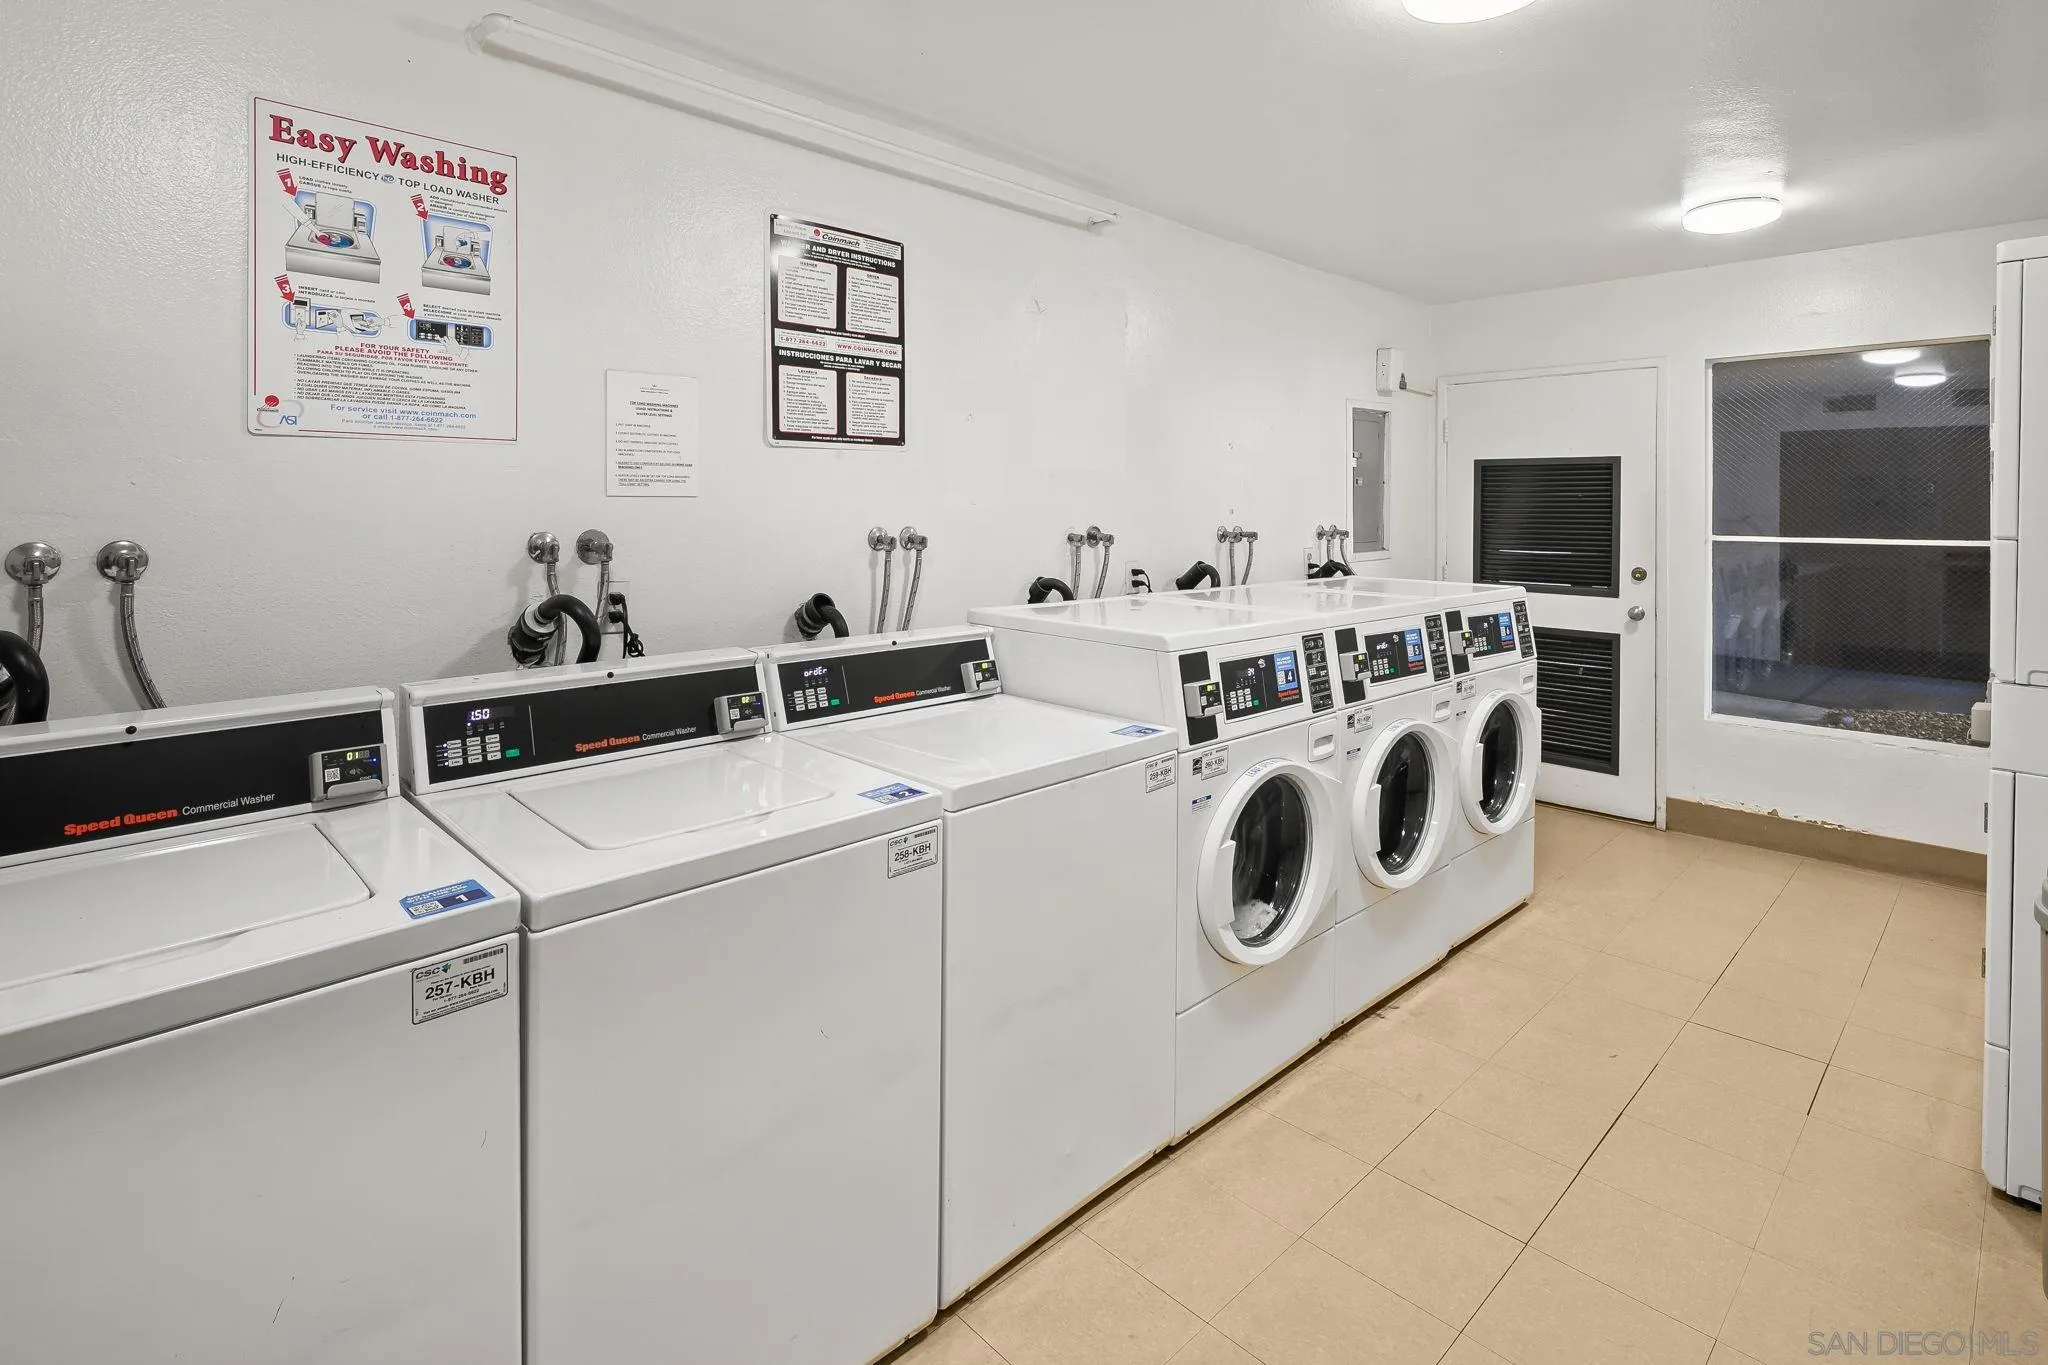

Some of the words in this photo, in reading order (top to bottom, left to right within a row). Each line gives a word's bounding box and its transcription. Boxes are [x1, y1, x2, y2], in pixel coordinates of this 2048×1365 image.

[269, 113, 357, 163] Easy
[365, 136, 508, 196] Washing
[276, 153, 380, 181] HIGH-EFFICIENCY
[284, 178, 291, 187] 1
[399, 177, 420, 187] TOP
[423, 182, 453, 195] LOAD
[455, 189, 499, 204] WASHER
[417, 203, 424, 211] 2
[822, 233, 860, 247] Coinmach
[812, 245, 826, 253] AND
[828, 248, 850, 259] DRYER
[851, 252, 896, 268] INSTRUCTIONS
[282, 284, 290, 293] 3
[403, 303, 411, 311] 4
[334, 345, 364, 353] PLEASE
[410, 352, 453, 361] FOLLOWING
[401, 346, 429, 354] SAFETY
[837, 343, 897, 355] WWW.COINMACH.COM
[778, 349, 834, 362] INSTRUCCIONES
[835, 356, 853, 364] PARA
[854, 358, 875, 366] LAVAR
[881, 361, 902, 369] SECAR
[347, 405, 377, 413] service
[399, 408, 476, 419] www.coinmach.com
[390, 414, 443, 423] 1-877-264-6622
[1415, 645, 1419, 655] 5
[1287, 670, 1293, 682] 4
[874, 693, 895, 703] Speed
[895, 691, 916, 699] Queen
[916, 688, 938, 696] Commercial
[575, 741, 608, 753] Speed
[609, 734, 641, 747] Queen
[642, 729, 676, 741] Commercial
[676, 726, 697, 736] Washer
[64, 815, 121, 837] Speed
[124, 807, 178, 827] Queen
[182, 798, 239, 817] Commercial
[240, 792, 276, 806] Washer
[894, 842, 931, 862] 258-KBH
[455, 894, 469, 902] 1
[415, 967, 441, 980] CSC
[425, 967, 495, 1001] 257-KBH
